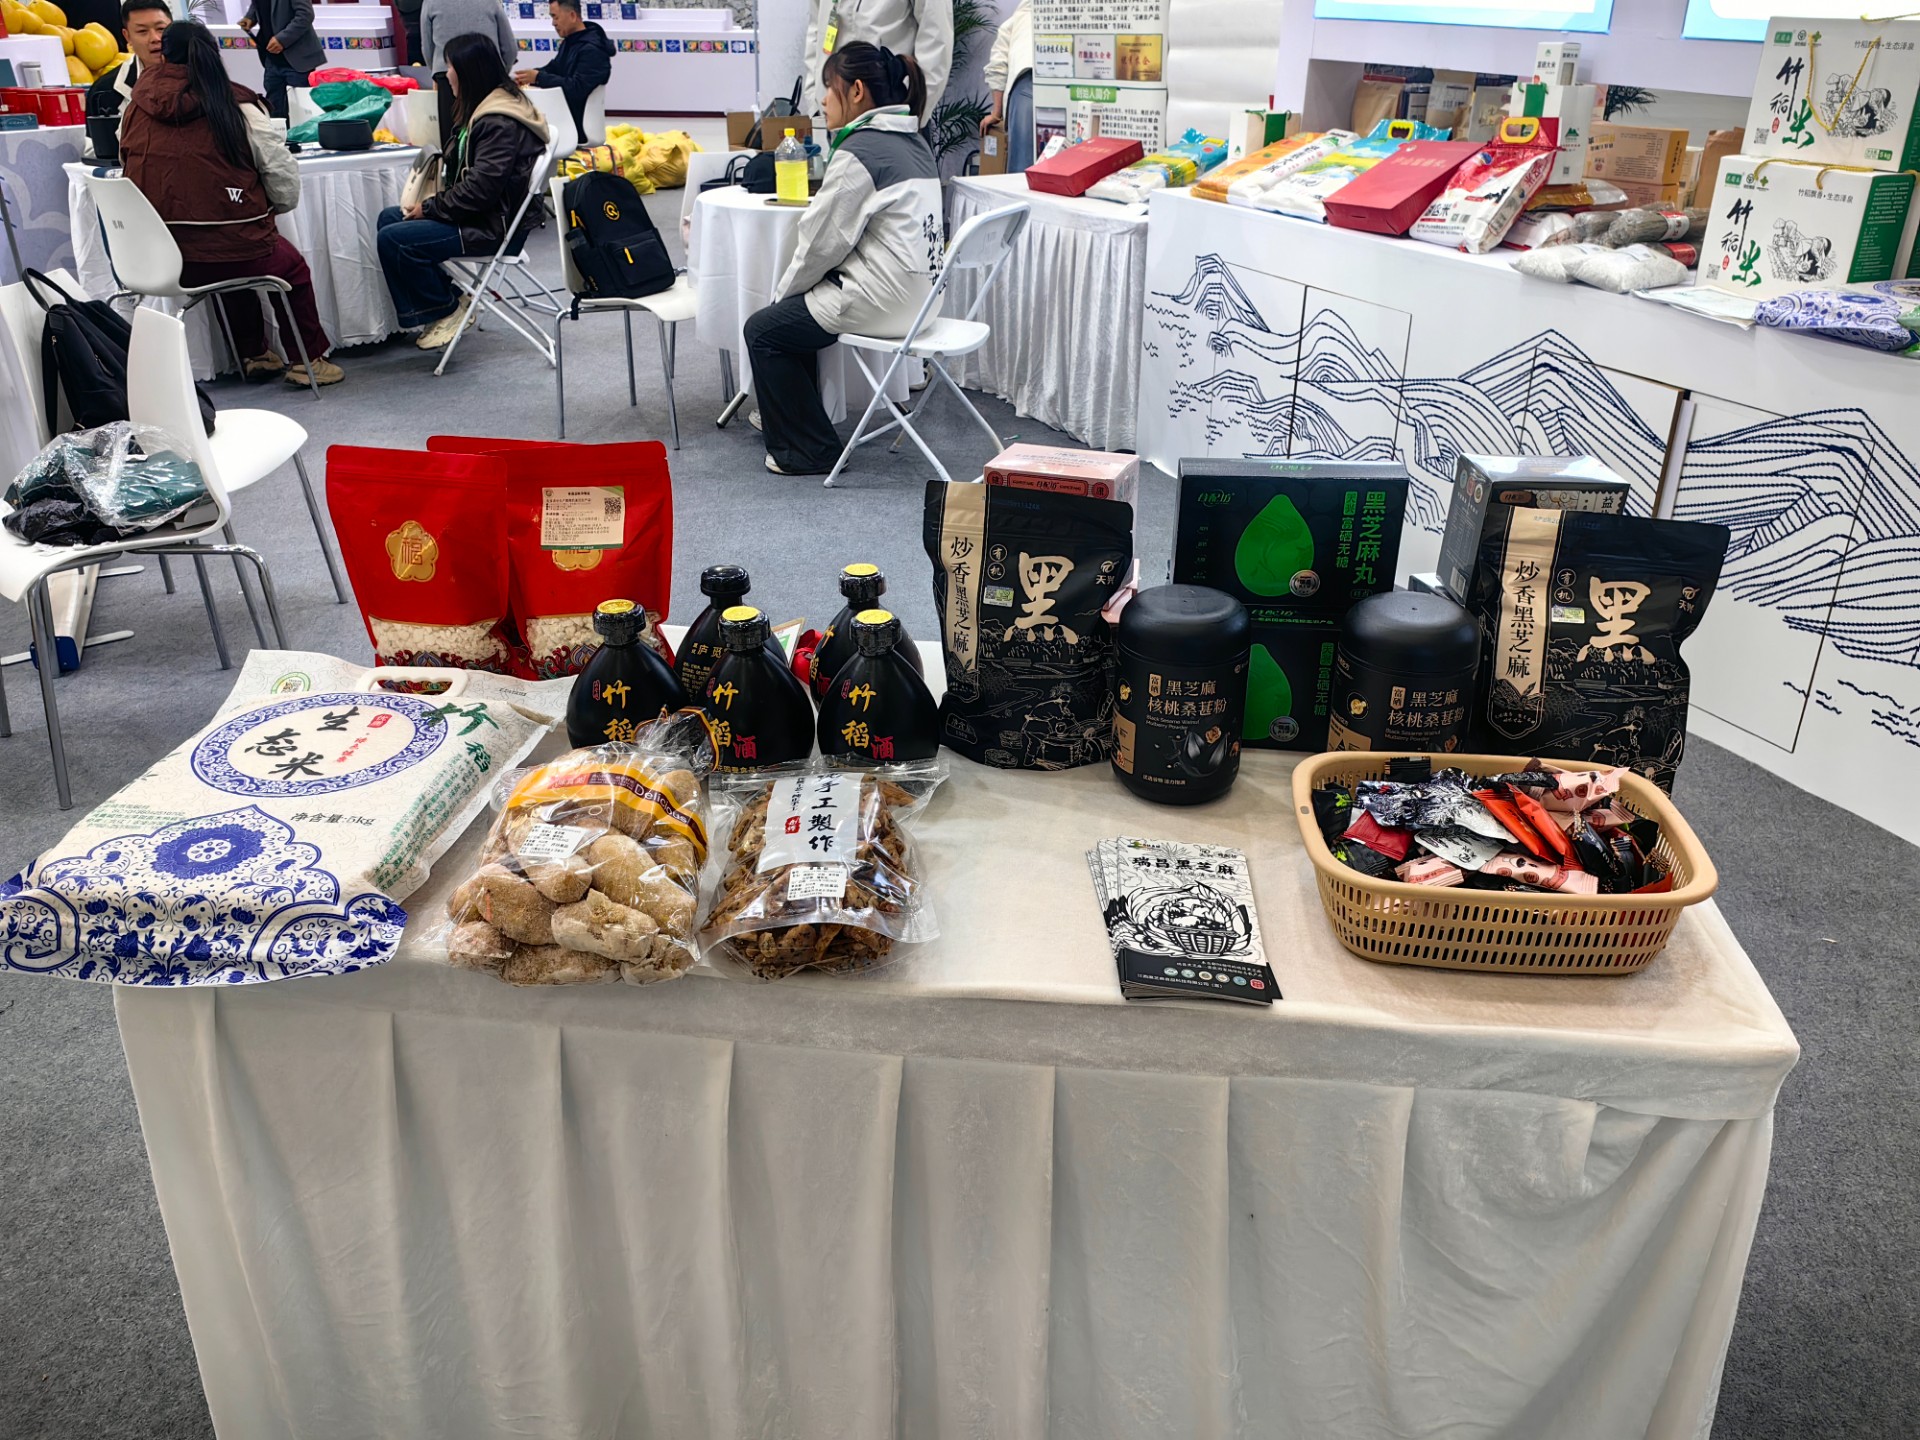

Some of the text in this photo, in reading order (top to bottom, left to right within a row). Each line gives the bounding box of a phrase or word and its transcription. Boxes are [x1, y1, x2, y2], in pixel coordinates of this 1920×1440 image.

[1076, 87, 1111, 100] 创始人简介
[401, 536, 423, 567] 福
[1335, 517, 1353, 568] 富硒无糖
[1352, 491, 1387, 585] 黑芝麻丸
[989, 546, 1005, 578] 有机
[950, 536, 975, 654] 炒香黑芝麻
[1095, 574, 1116, 586] 天兴
[1556, 570, 1574, 601] 有机
[1003, 551, 1079, 645] 黑
[1678, 599, 1695, 614] 天兴
[1505, 560, 1541, 679] 炒香黑芝麻
[1576, 576, 1656, 665] 黑
[1165, 680, 1217, 697] 黑芝麻
[1314, 667, 1332, 716] 富硒无糖
[1410, 689, 1459, 707] 黑芝麻
[1147, 697, 1228, 717] 核桃桑葚粉
[634, 783, 689, 824] Delicious
